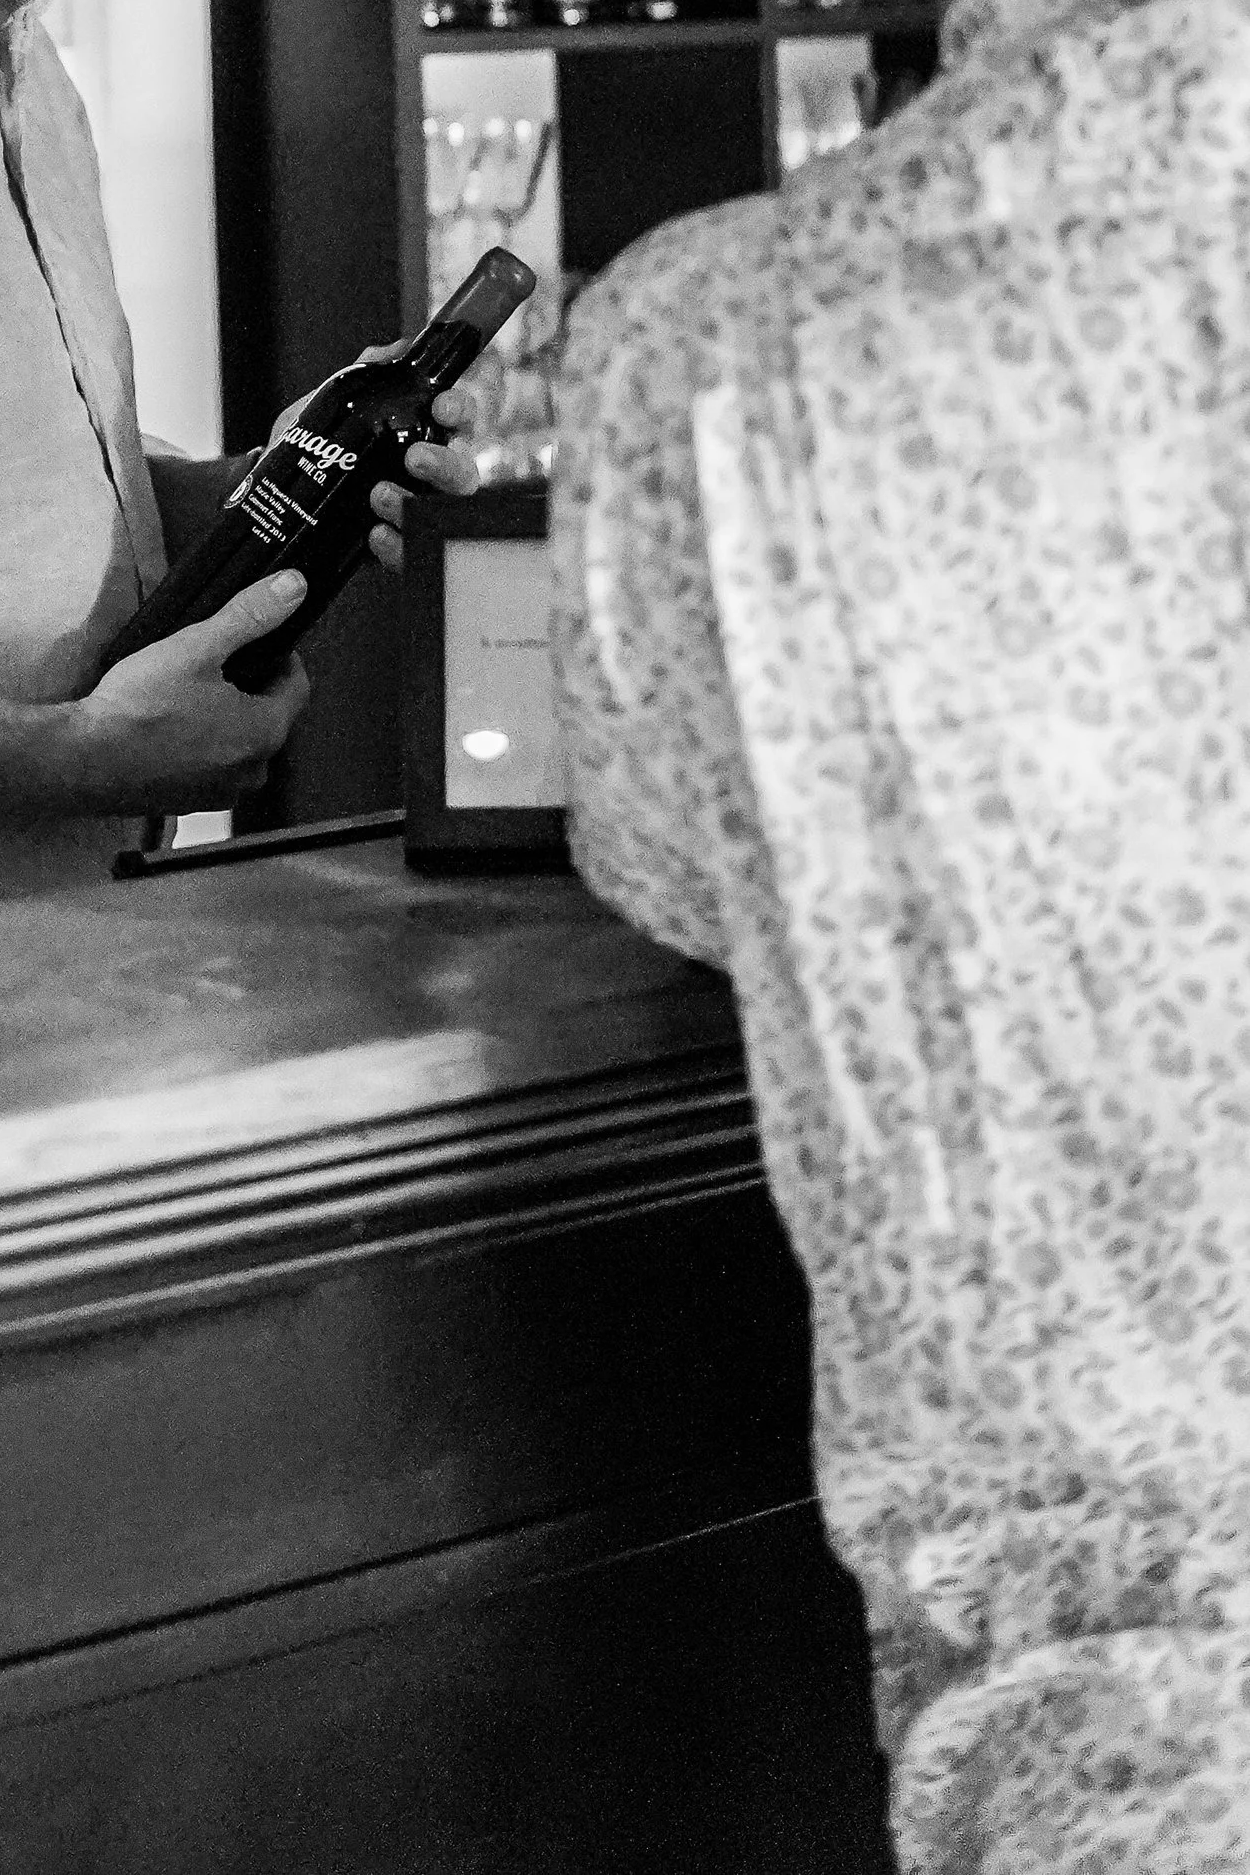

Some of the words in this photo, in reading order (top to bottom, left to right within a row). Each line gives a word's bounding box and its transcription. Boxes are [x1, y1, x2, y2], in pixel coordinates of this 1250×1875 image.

[283, 416, 358, 471] arage
[297, 456, 317, 476] WINE
[269, 496, 286, 514] Valley
[291, 501, 319, 526] Vineyard
[267, 509, 283, 525] Franc
[269, 526, 286, 542] 2013
